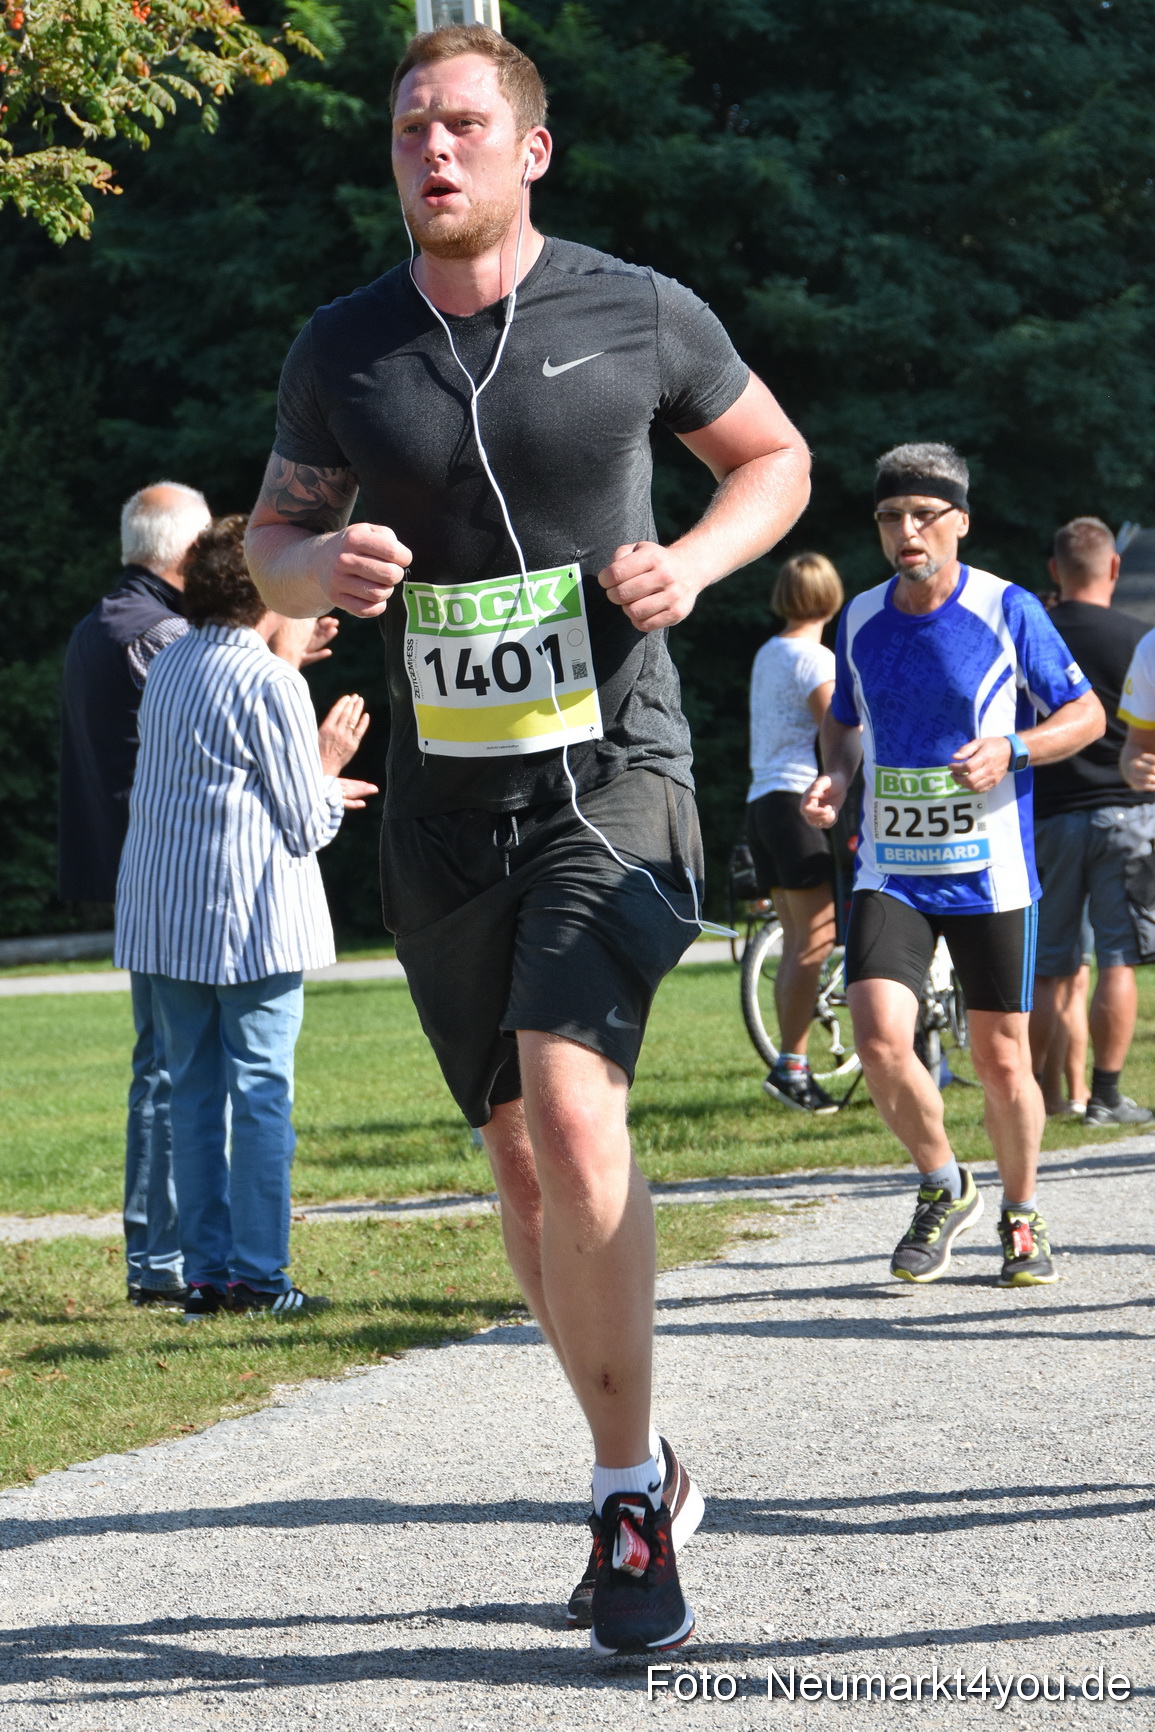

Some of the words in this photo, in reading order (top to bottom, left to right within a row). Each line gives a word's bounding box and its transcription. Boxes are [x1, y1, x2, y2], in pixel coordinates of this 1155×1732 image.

[415, 576, 568, 630] BOCK
[424, 633, 565, 697] 1401
[884, 803, 975, 838] 2255
[884, 844, 981, 862] BERNHARD
